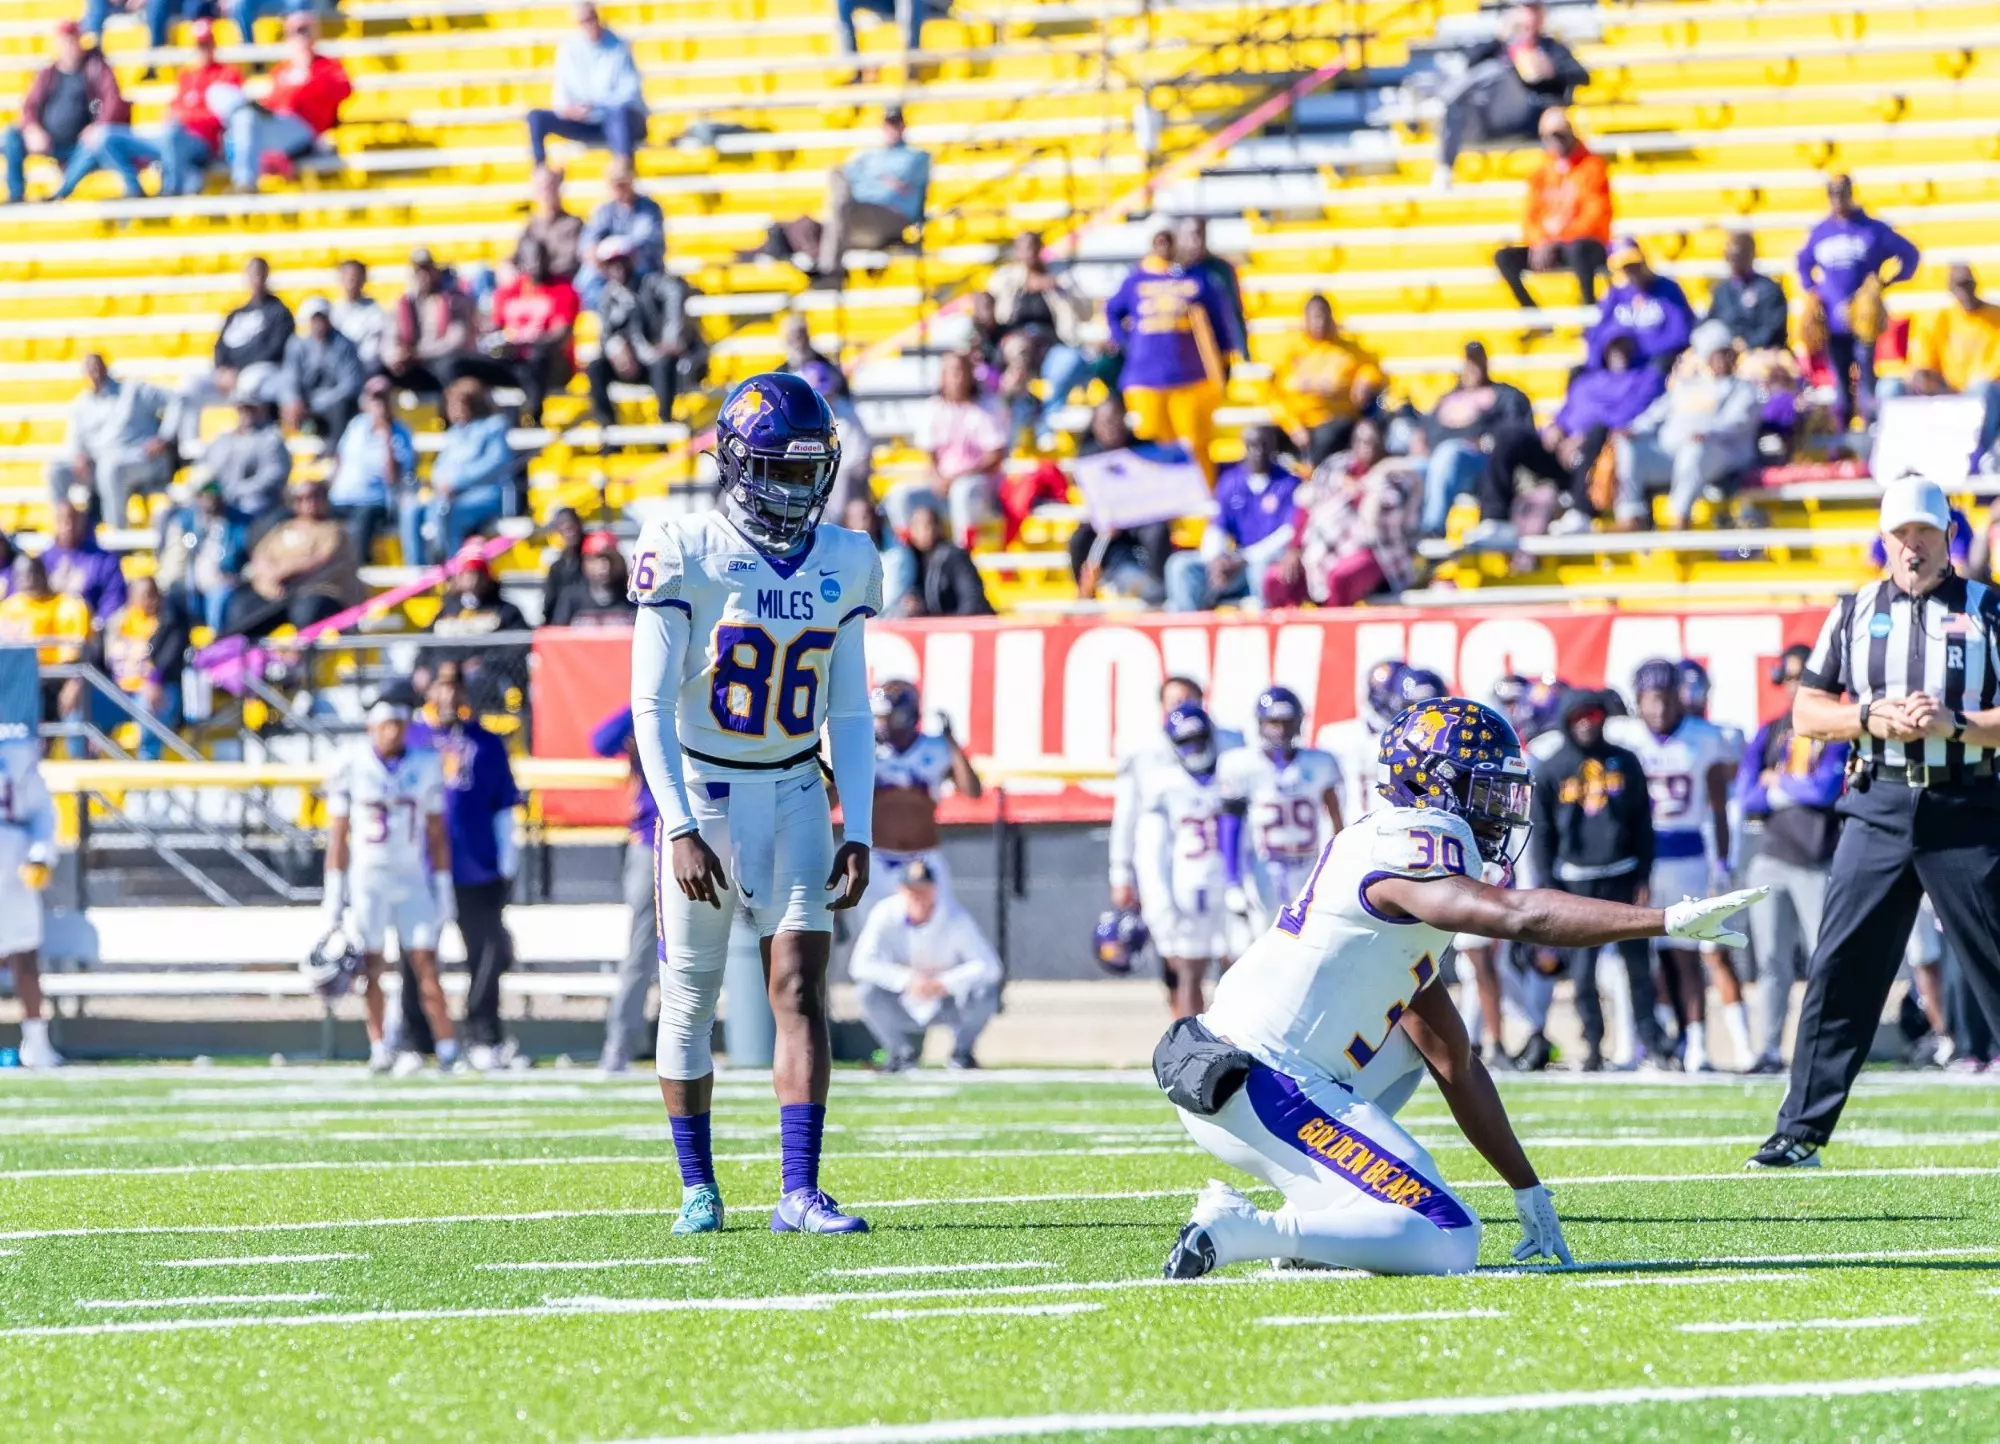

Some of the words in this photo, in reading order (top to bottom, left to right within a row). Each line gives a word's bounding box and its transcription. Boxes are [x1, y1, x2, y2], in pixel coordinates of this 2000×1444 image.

[794, 443, 822, 453] Riddell
[757, 588, 814, 621] MILES
[708, 621, 839, 739] 86
[1947, 645, 1964, 670] R
[364, 797, 417, 844] 37
[1262, 799, 1318, 855] 29
[1407, 829, 1467, 876] 30
[1297, 1117, 1376, 1175] GOLDEN
[1360, 1157, 1433, 1208] BEARS
